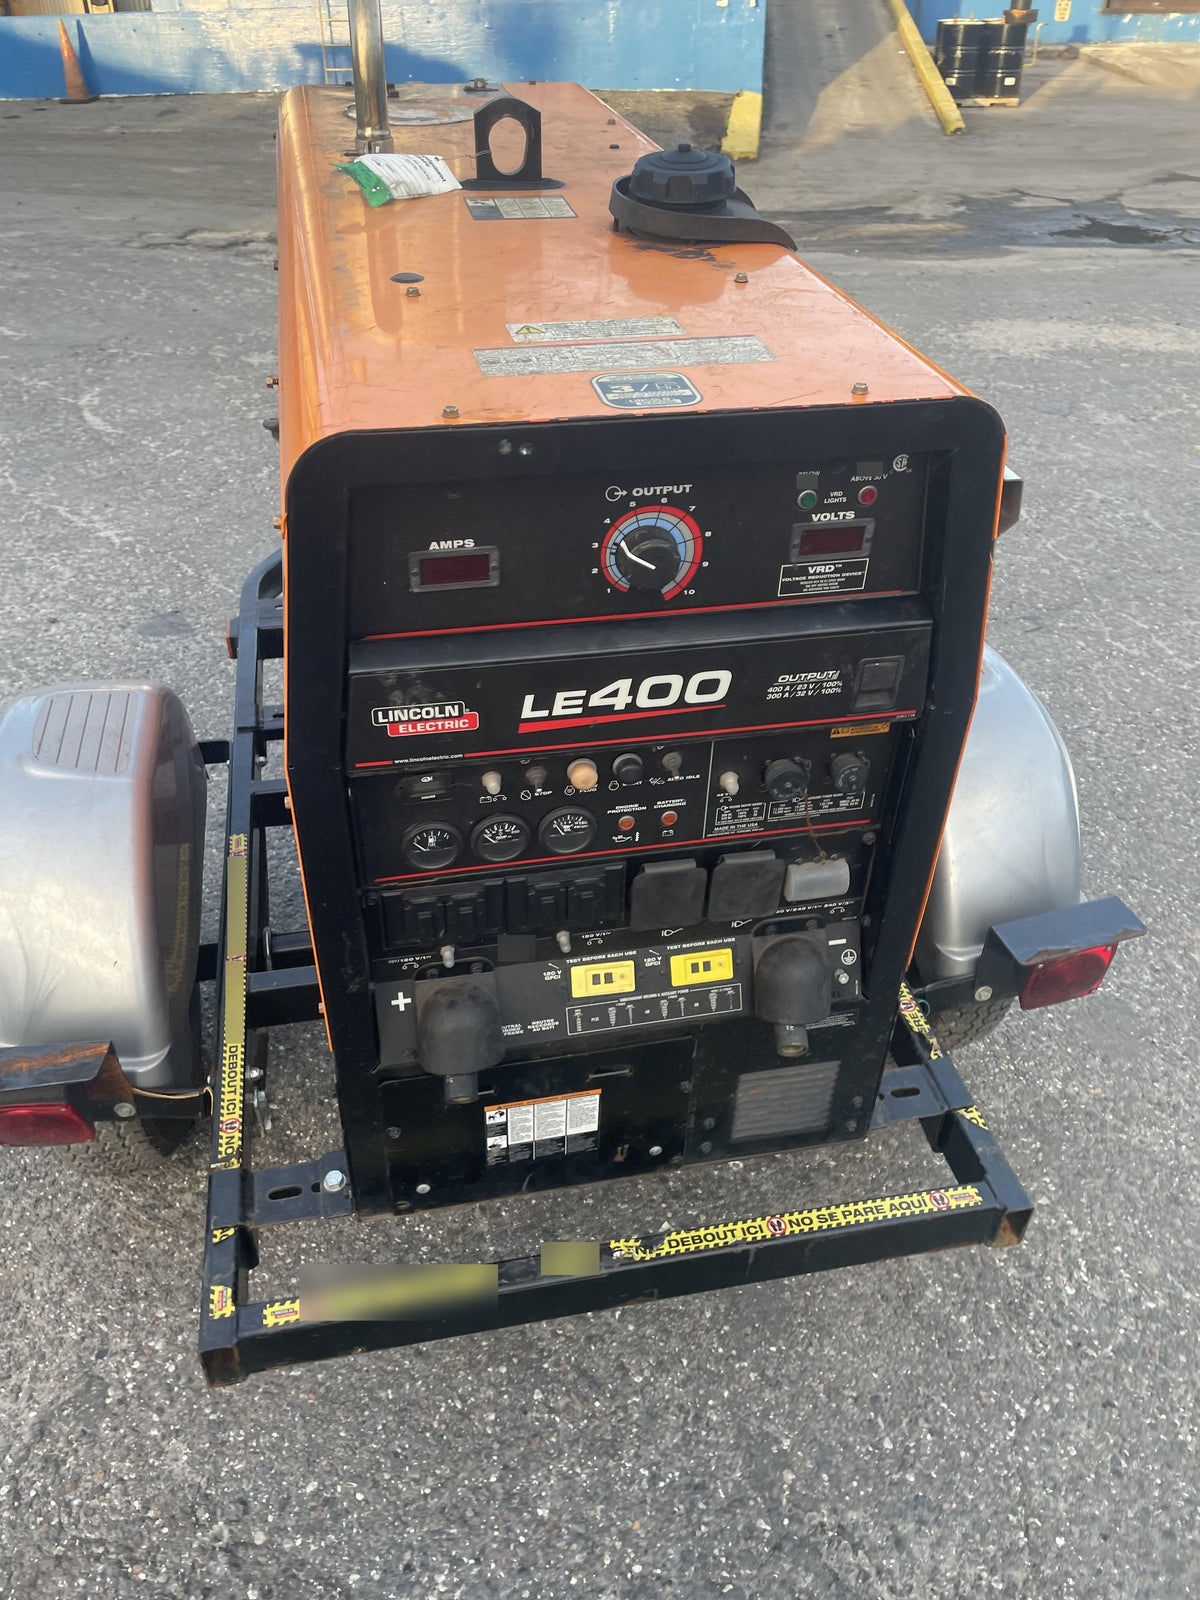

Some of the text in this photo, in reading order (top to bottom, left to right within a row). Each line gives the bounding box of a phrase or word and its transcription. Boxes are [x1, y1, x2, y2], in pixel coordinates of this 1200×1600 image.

[632, 484, 692, 496] OUTPUT
[811, 510, 855, 522] VOLTS
[429, 539, 475, 550] AMPS
[778, 670, 836, 682] OUTPUT
[520, 670, 733, 719] LE400
[378, 704, 459, 724] LINCOLN
[399, 719, 469, 733] ELECTRIC
[394, 753, 463, 764] www.lincolnelectric.com
[227, 1045, 238, 1115] DEBOUT ICI
[787, 1197, 928, 1231] NO SE PARE AQUÍ
[668, 1224, 764, 1250] DEBOUT ICI
